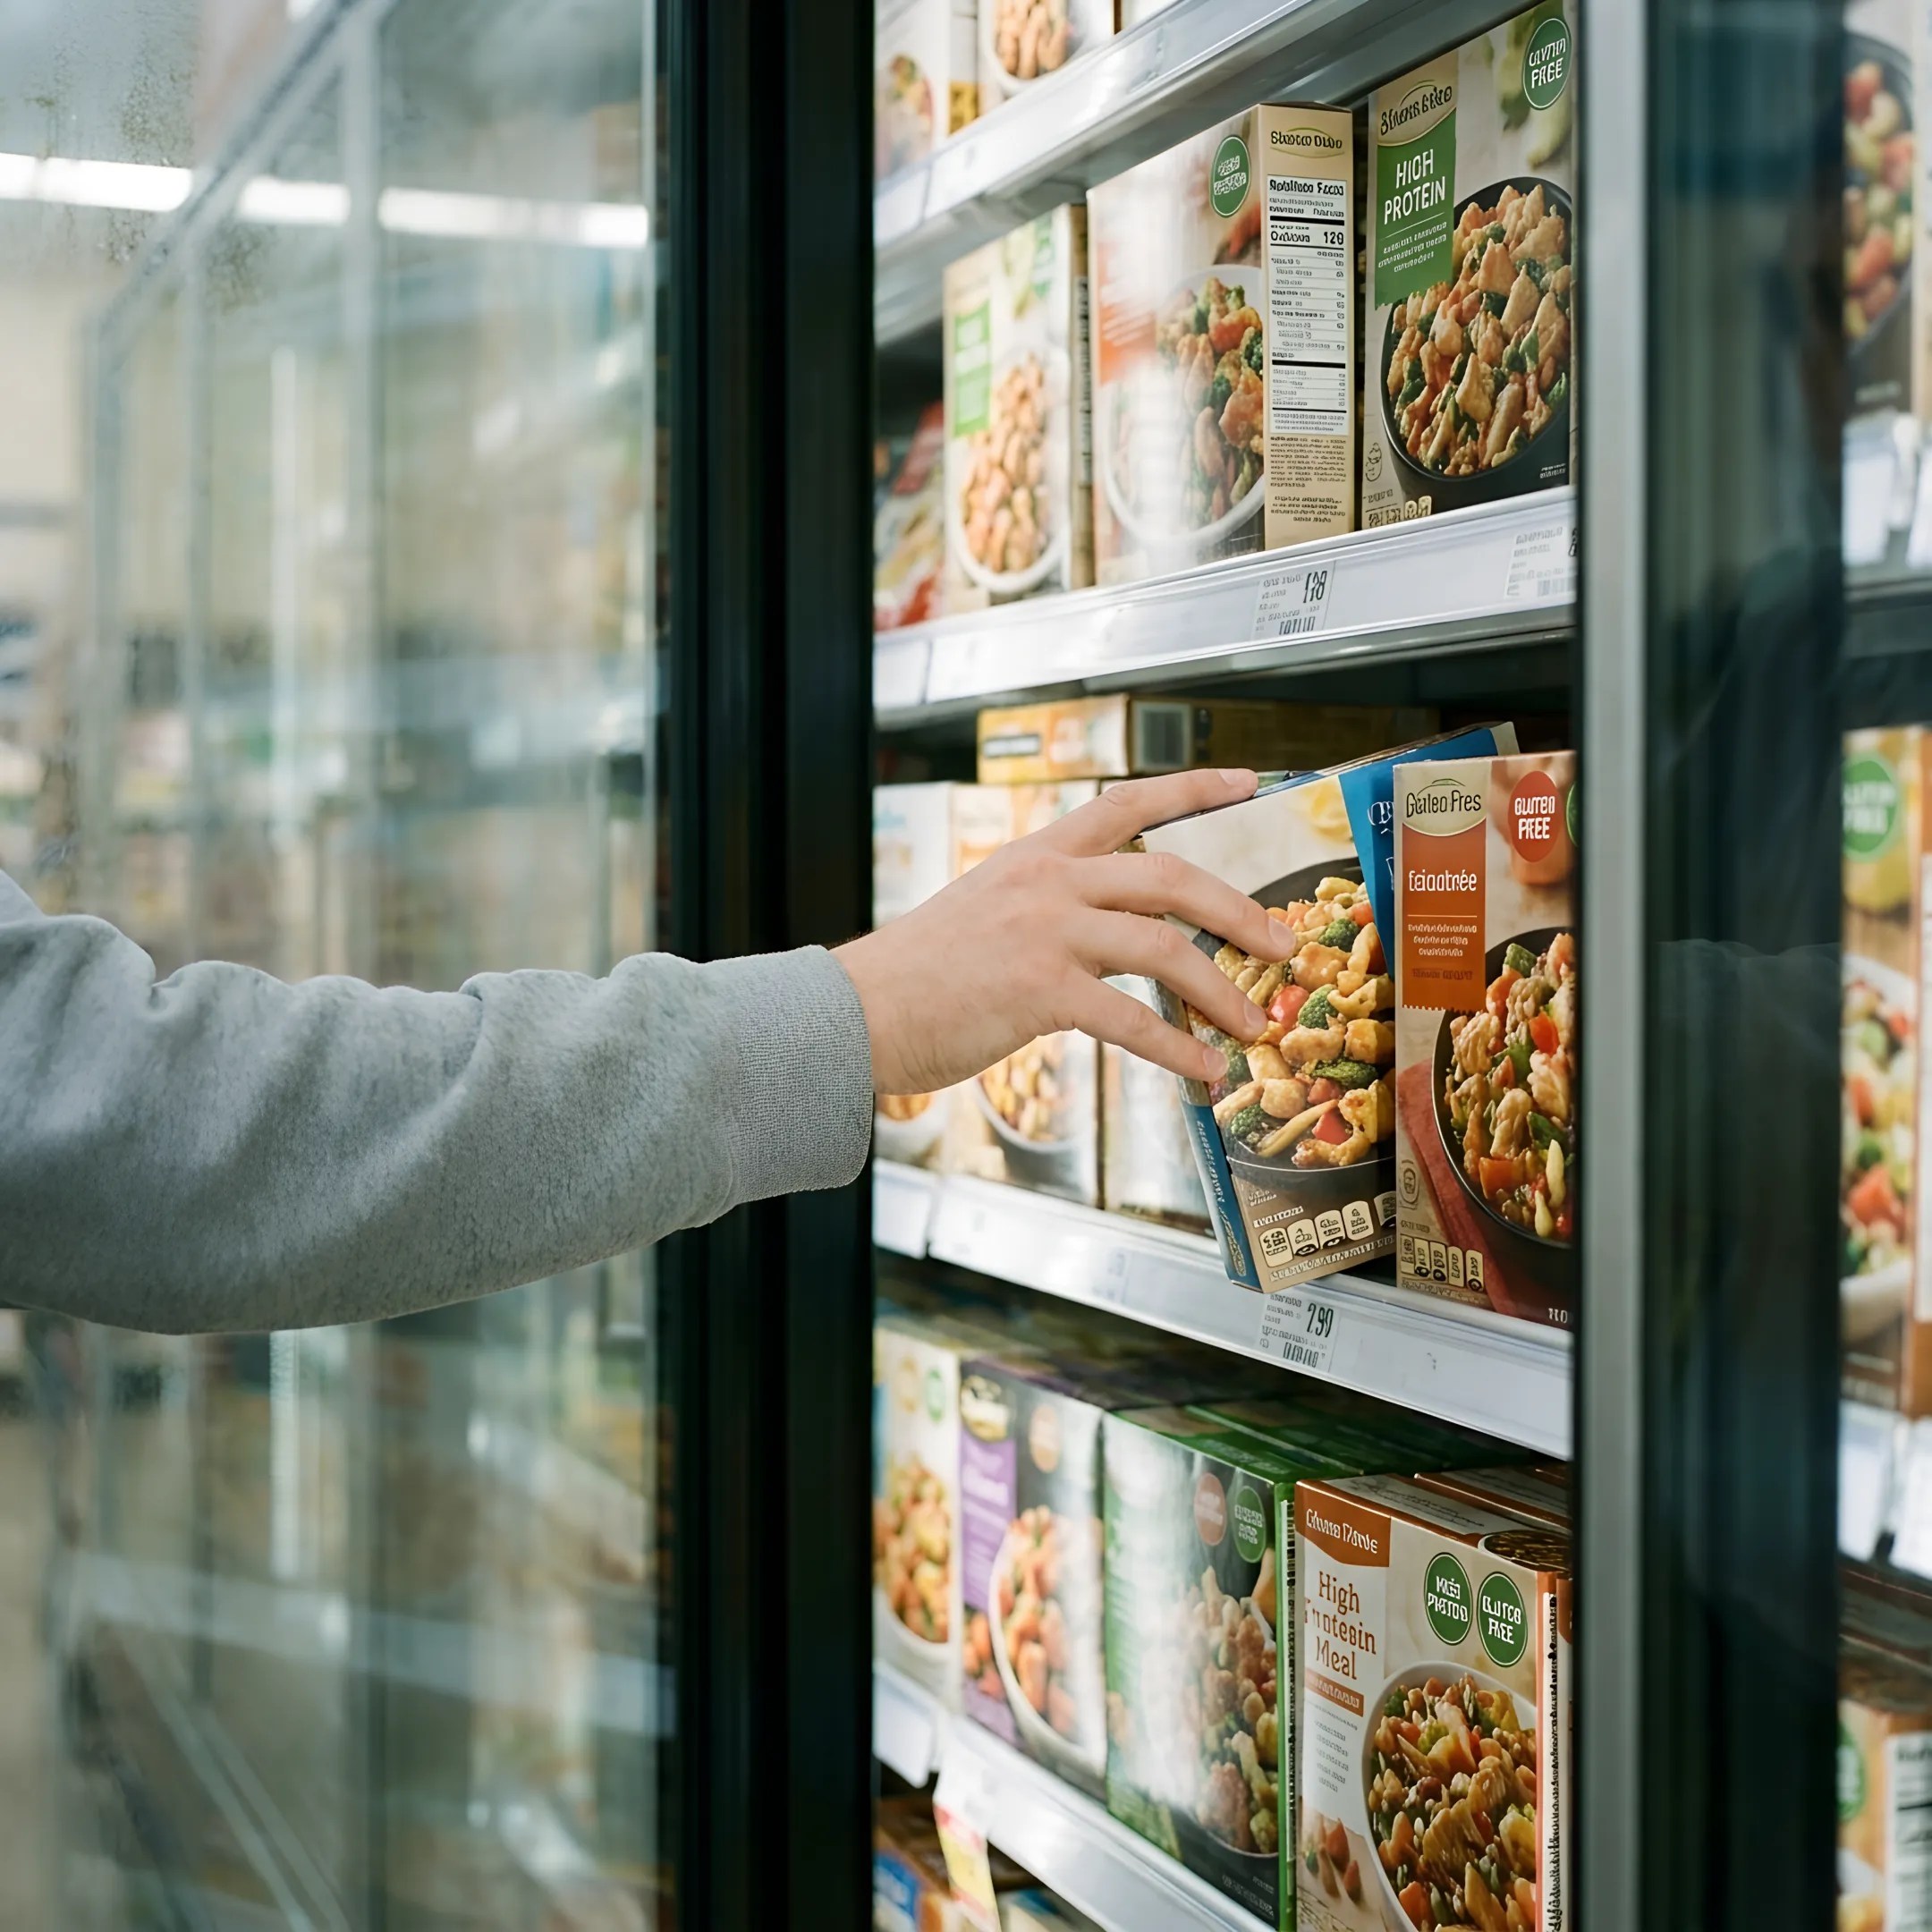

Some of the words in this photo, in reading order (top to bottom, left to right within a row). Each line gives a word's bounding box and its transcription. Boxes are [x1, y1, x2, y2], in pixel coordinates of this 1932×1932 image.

[1384, 175, 1446, 225] PROTEIN
[1318, 1571, 1360, 1615] High
[1316, 1635, 1358, 1681] Meal
